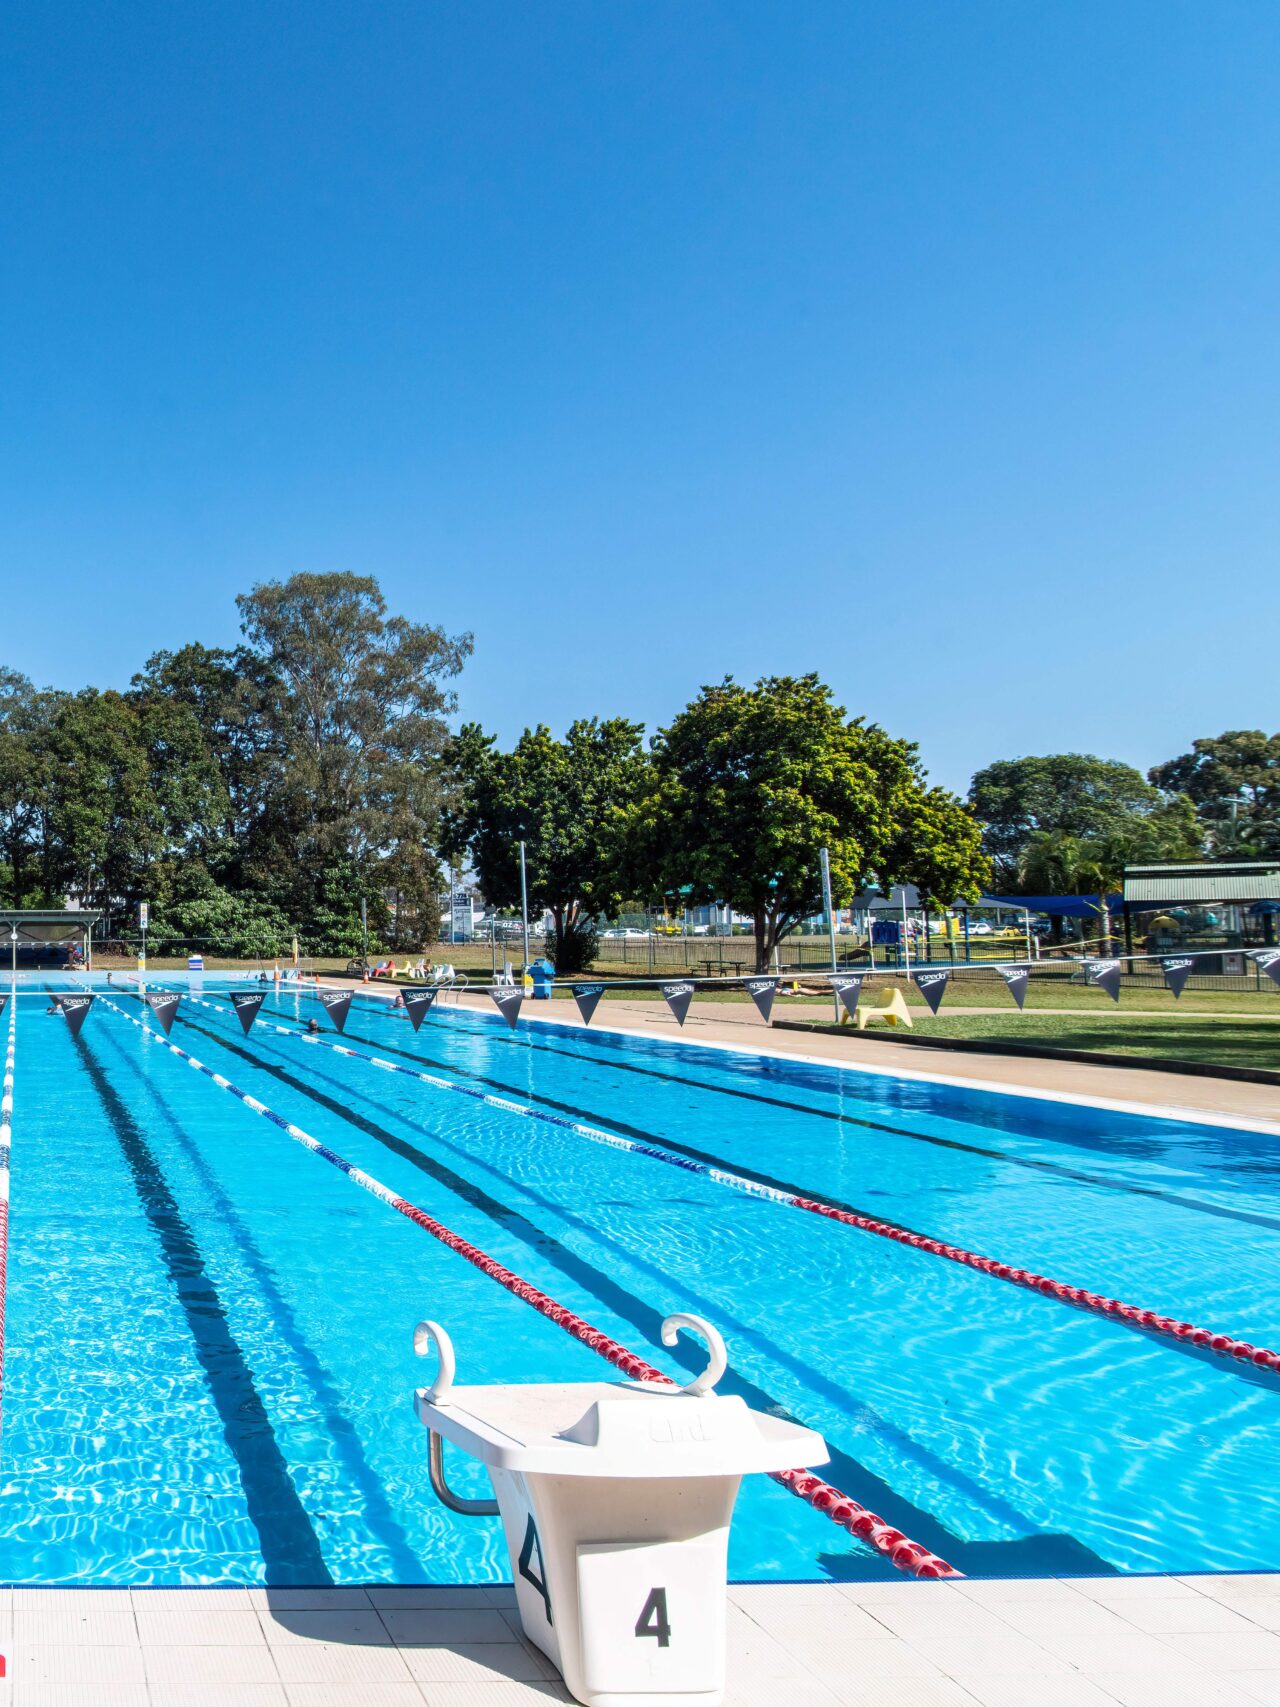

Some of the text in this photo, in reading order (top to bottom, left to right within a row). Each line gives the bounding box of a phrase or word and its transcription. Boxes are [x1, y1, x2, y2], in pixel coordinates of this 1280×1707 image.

[917, 973, 945, 982] speedo
[749, 981, 774, 989] speedo
[323, 993, 351, 1001] speedo
[493, 988, 521, 998] speedo
[63, 998, 90, 1006] speedo
[151, 994, 179, 1003] speedo
[518, 1512, 553, 1627] 4
[635, 1587, 671, 1648] 4
